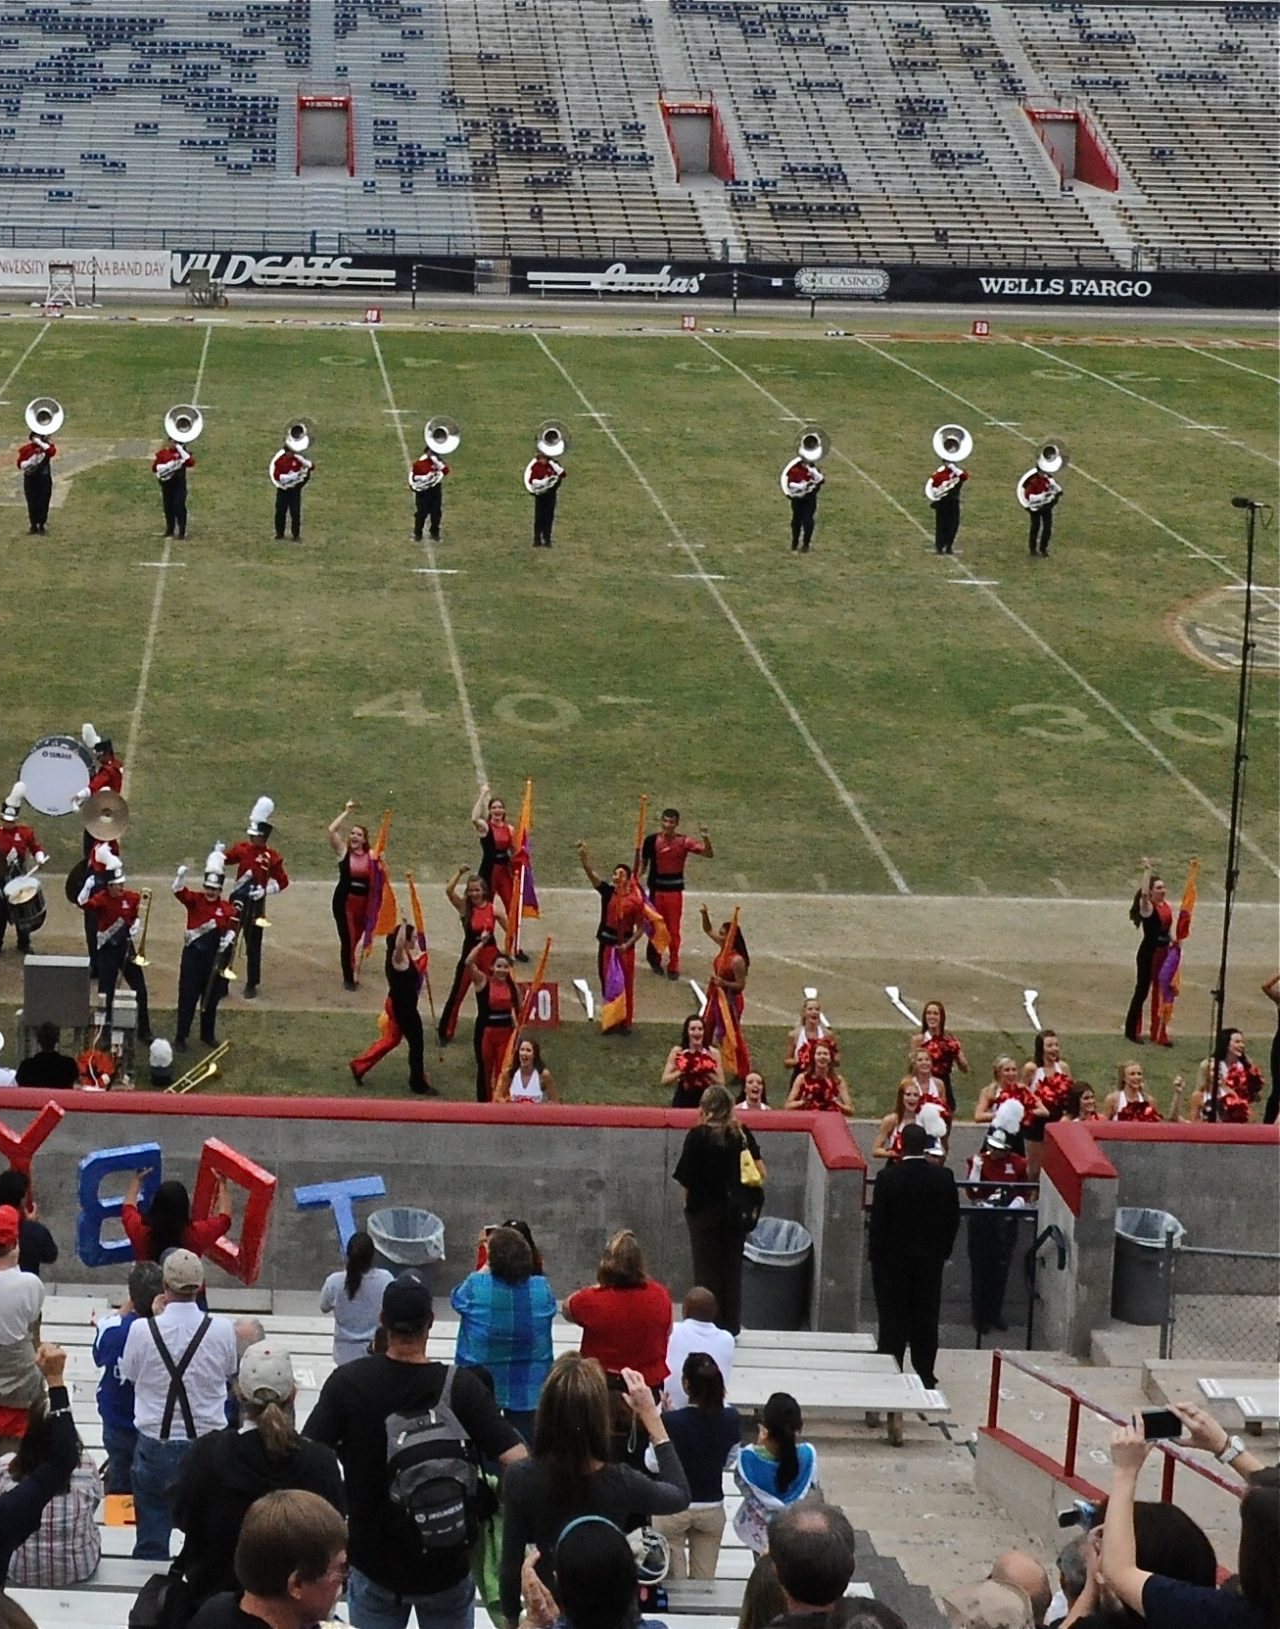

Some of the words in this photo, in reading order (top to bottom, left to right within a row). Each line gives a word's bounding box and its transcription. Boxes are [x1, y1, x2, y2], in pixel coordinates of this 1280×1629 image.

[113, 261, 142, 276] BAND
[145, 262, 166, 277] DAY
[829, 276, 880, 287] CASINOS
[979, 277, 1065, 296] WELLS
[1069, 279, 1152, 297] FARGO
